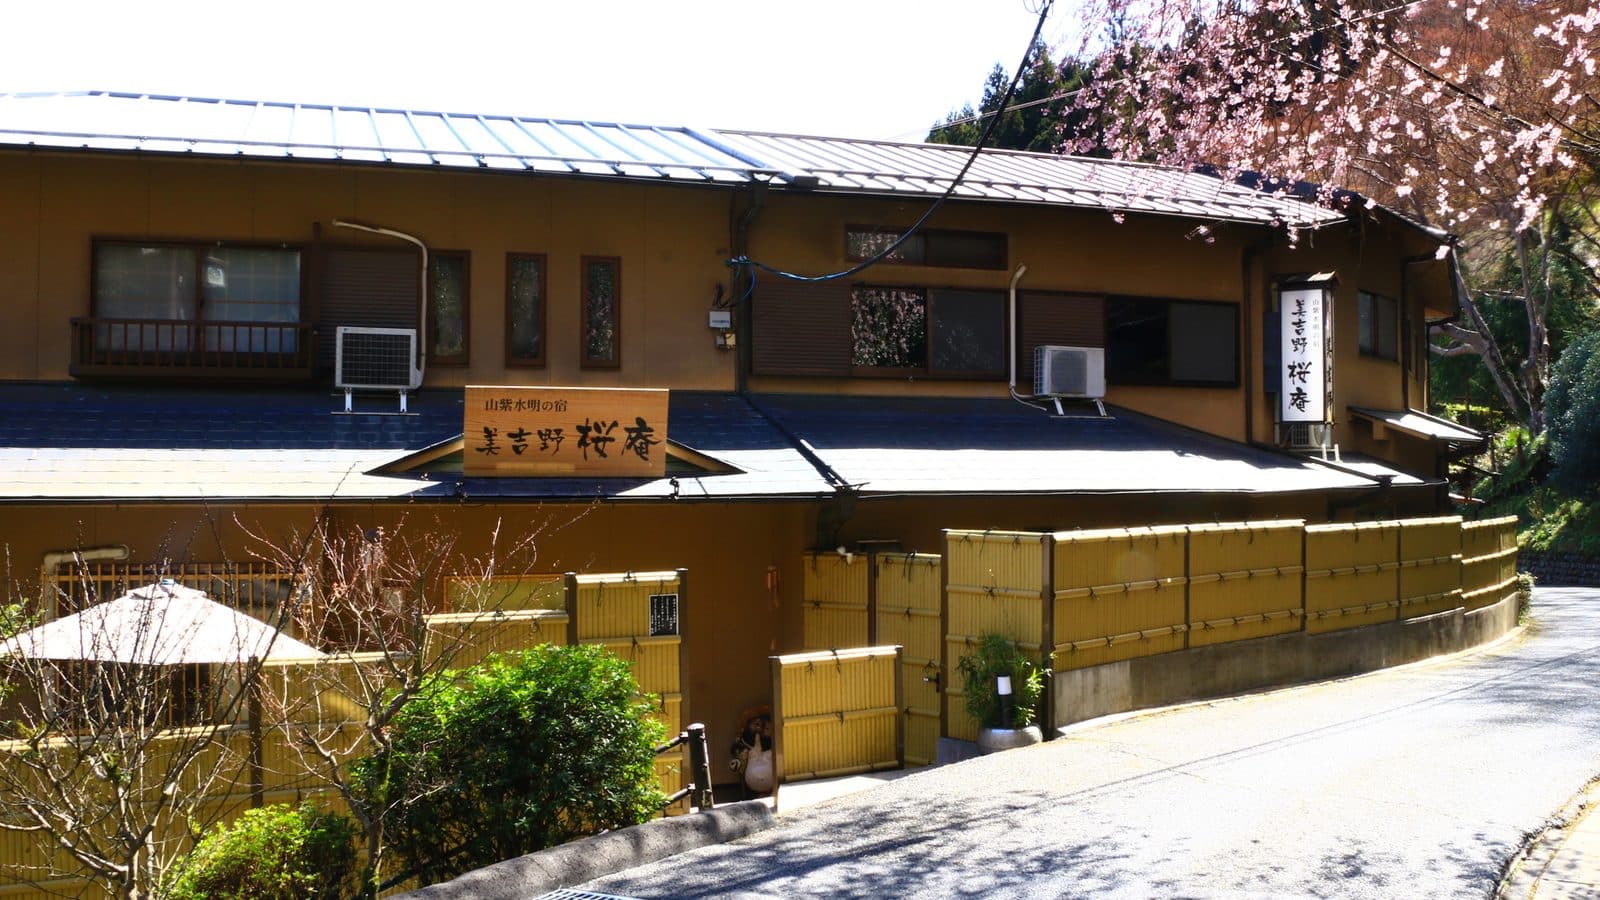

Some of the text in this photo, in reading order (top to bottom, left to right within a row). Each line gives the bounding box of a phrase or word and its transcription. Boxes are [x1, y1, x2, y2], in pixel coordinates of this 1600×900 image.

[485, 398, 568, 412] 山紫水明の宿
